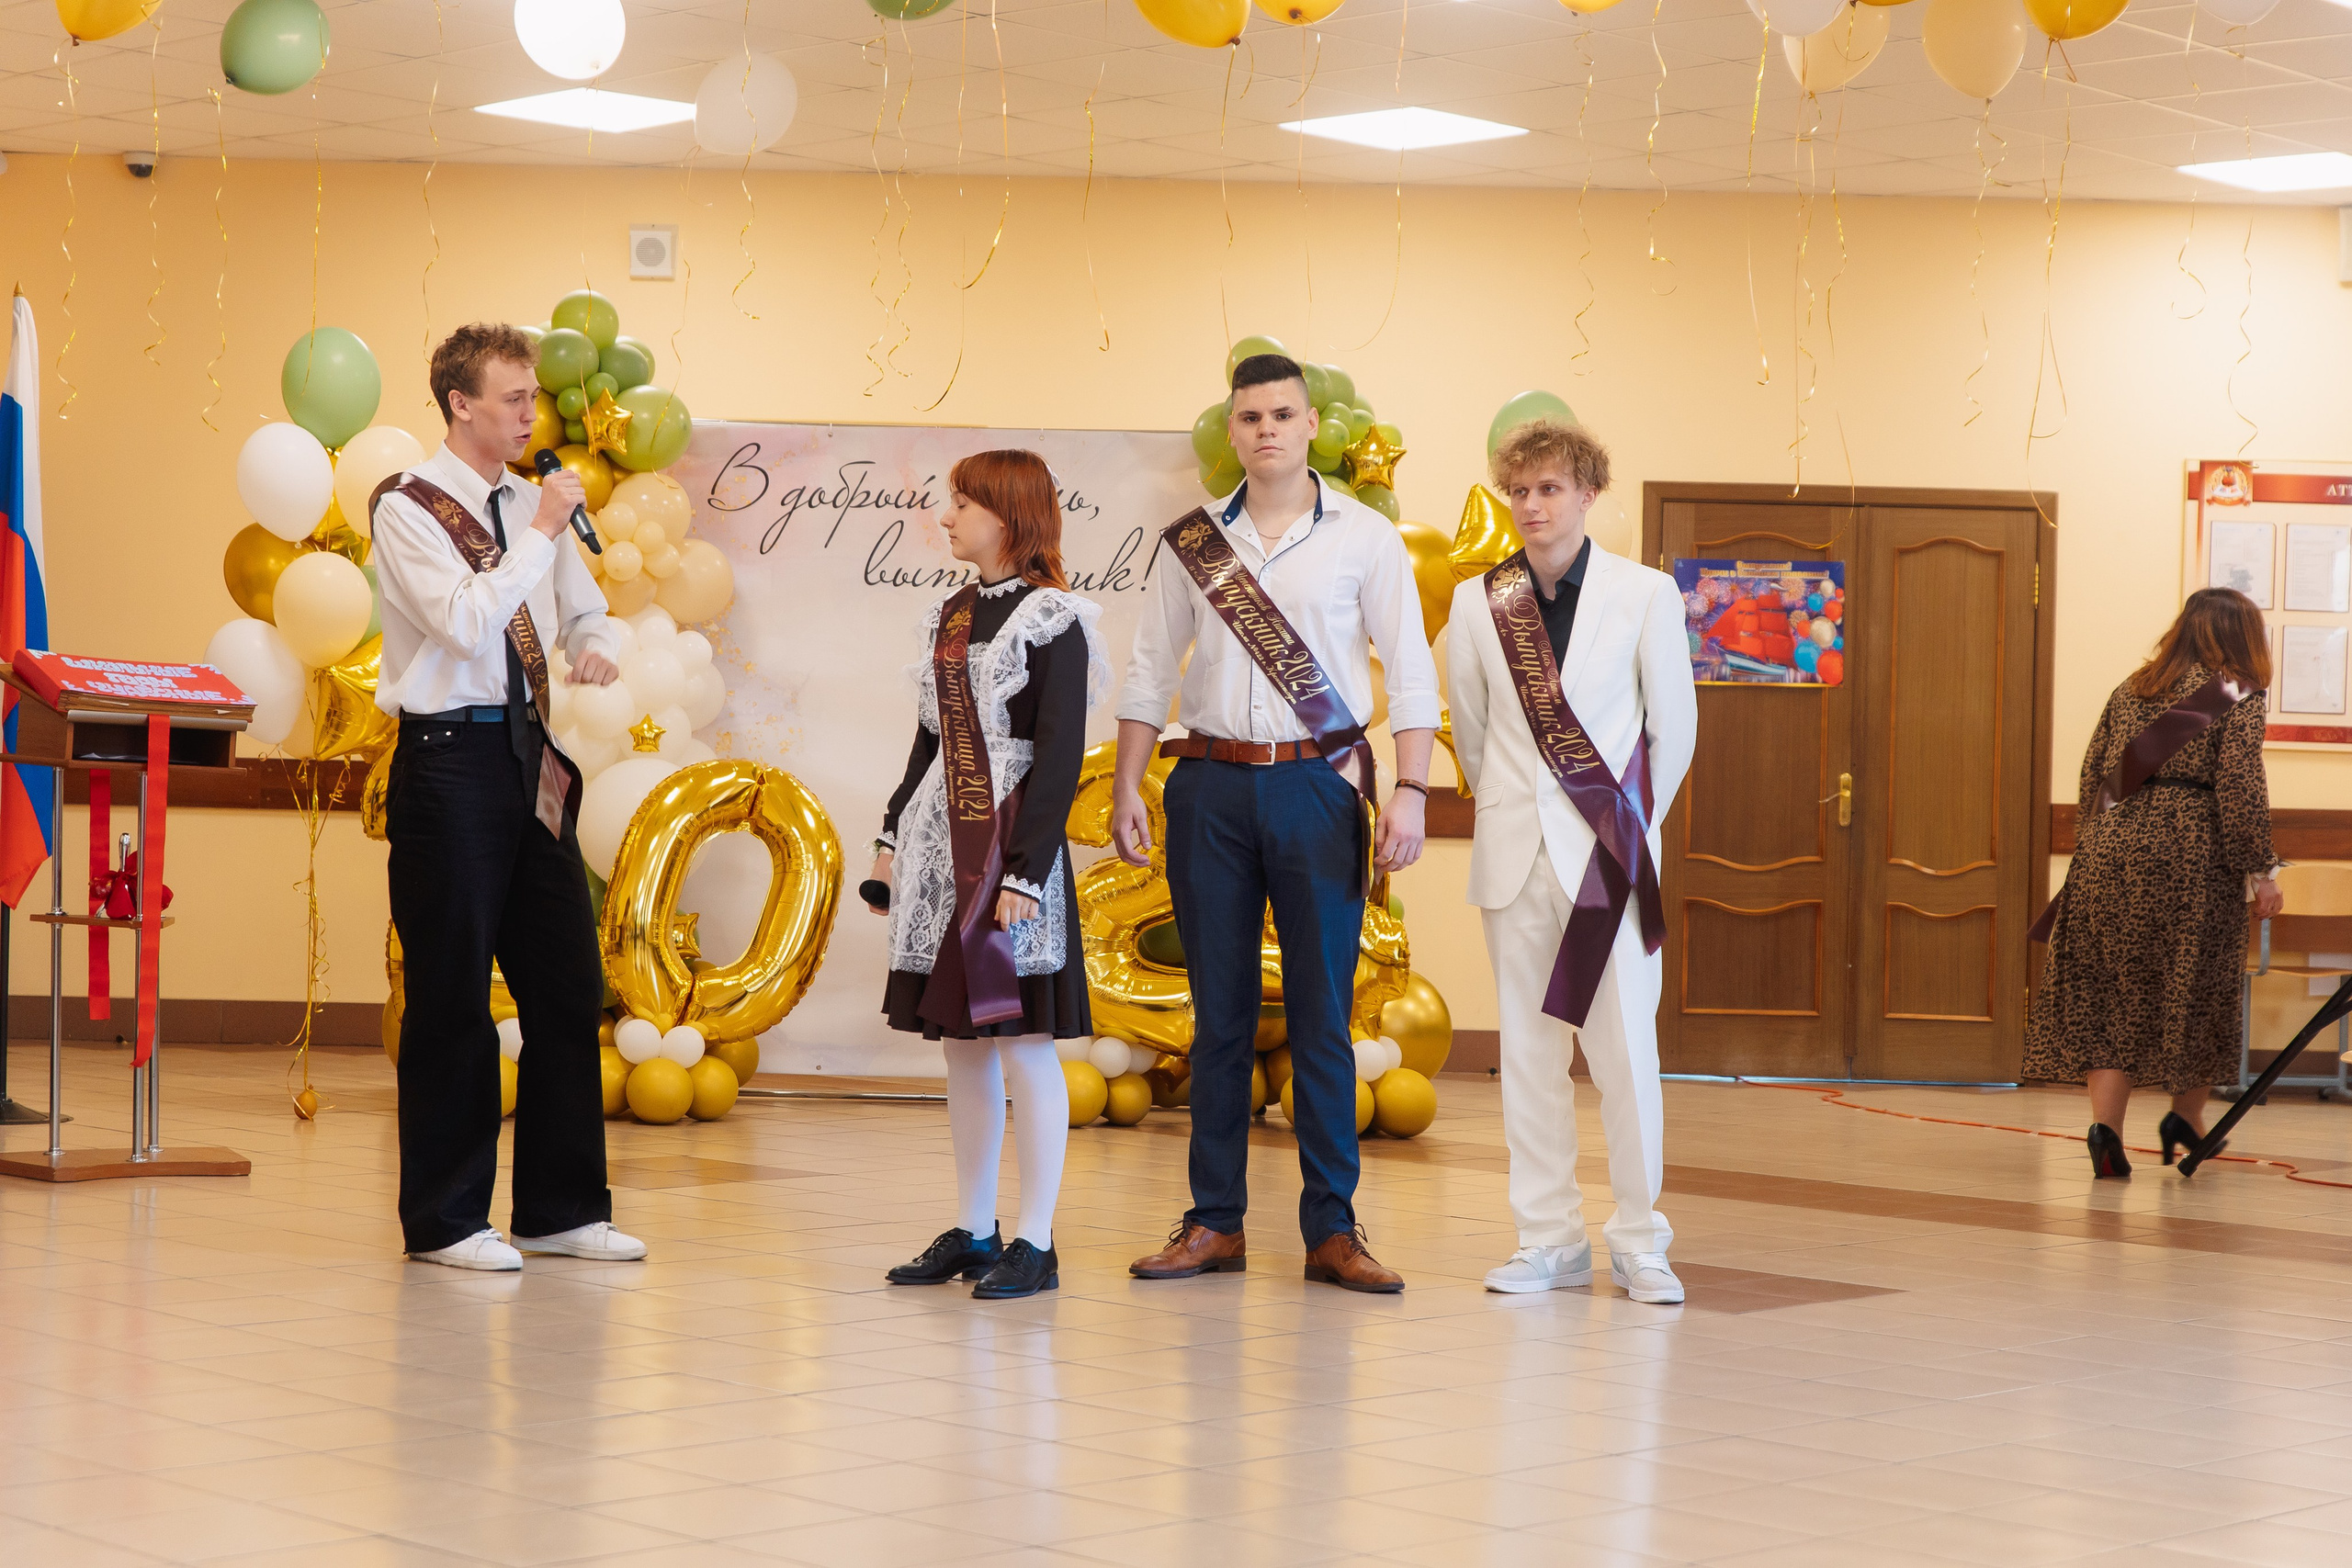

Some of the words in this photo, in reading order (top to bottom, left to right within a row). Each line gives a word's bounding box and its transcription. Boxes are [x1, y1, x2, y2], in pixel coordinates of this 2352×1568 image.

[707, 442, 770, 512] В
[759, 460, 940, 555] добрый
[864, 519, 1164, 592] выпик!
[1197, 541, 1289, 660] Выпускник
[1274, 650, 1330, 701] 2024
[941, 637, 976, 773] Выпускница
[1504, 594, 1562, 732] Выпускник
[1545, 728, 1600, 774] 2024
[957, 774, 990, 821] 2024
